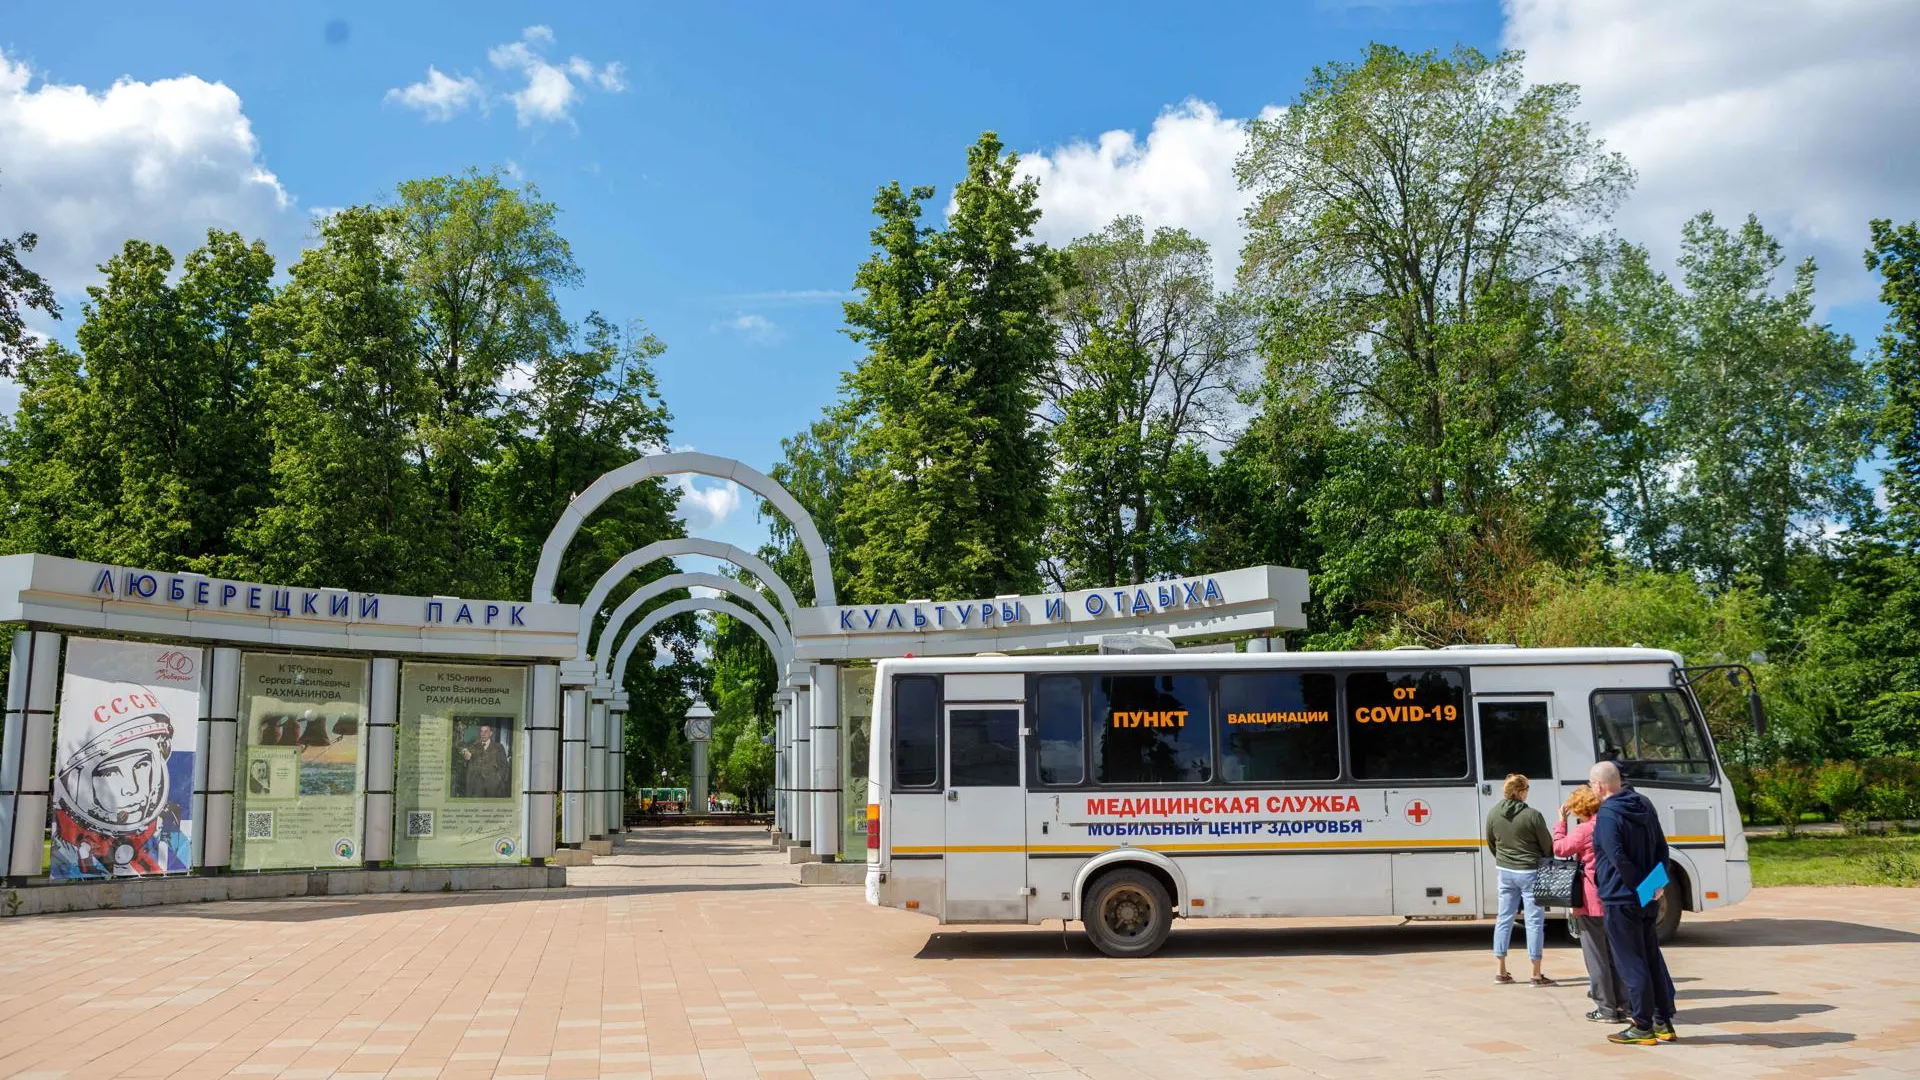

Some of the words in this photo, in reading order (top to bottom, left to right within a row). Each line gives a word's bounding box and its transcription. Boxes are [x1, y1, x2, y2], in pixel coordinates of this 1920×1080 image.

[95, 569, 379, 618] ЛЮБЕРЕЦКИЙ
[427, 602, 525, 626] ПАРК
[840, 601, 1020, 629] КУЛЬТУРЫ
[1045, 598, 1062, 619] И
[1085, 578, 1219, 615] ОТДЫХА
[157, 651, 194, 675] 400
[279, 664, 285, 673] К
[288, 664, 333, 676] 150-летию
[258, 675, 292, 686] Сергея
[438, 673, 444, 681] К
[447, 673, 492, 683] 150-летию
[266, 688, 341, 699] РАХМАНИНОВА
[419, 684, 451, 693] Сергея
[453, 685, 510, 695] Васильевича
[94, 694, 157, 723] СССР
[426, 695, 501, 705] РАХМАНИНОВА
[1113, 710, 1189, 728] ПУНКТ
[1227, 711, 1329, 726] ВАКЦИНАЦИИ
[1355, 704, 1457, 724] COVID-19
[1087, 796, 1260, 818] МЕДИЦИНСКАЯ
[1267, 795, 1361, 814] СЛУЖБА
[1088, 818, 1203, 836] МОБИЛЬНЫЙ
[1208, 821, 1263, 837] ЦЕНТР
[1268, 819, 1362, 836] ЗДОРОВЬЯ
